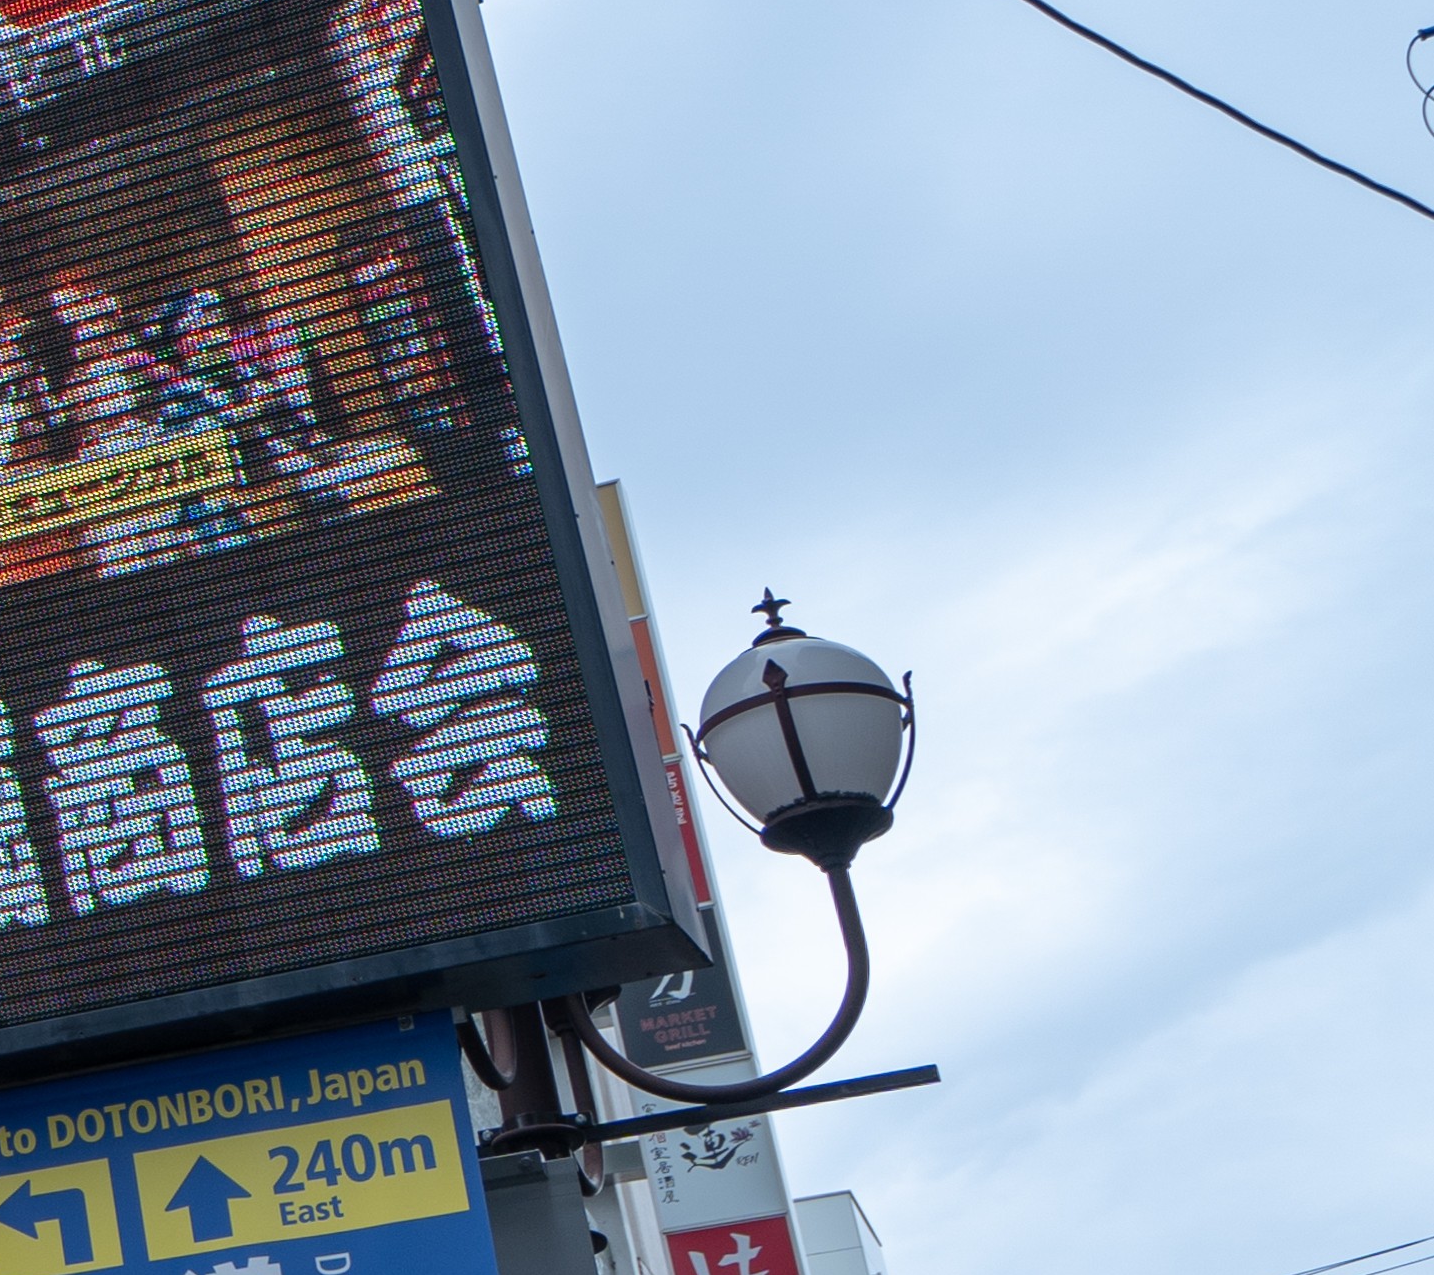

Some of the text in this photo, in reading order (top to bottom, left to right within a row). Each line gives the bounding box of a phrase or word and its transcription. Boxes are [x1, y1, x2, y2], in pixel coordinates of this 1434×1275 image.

[640, 1004, 718, 1032] MARKET
[654, 1024, 711, 1044] GRILL
[305, 1055, 427, 1111] Japan
[267, 1125, 438, 1228] 240m East
[642, 1103, 680, 1204] 個室居酒屋
